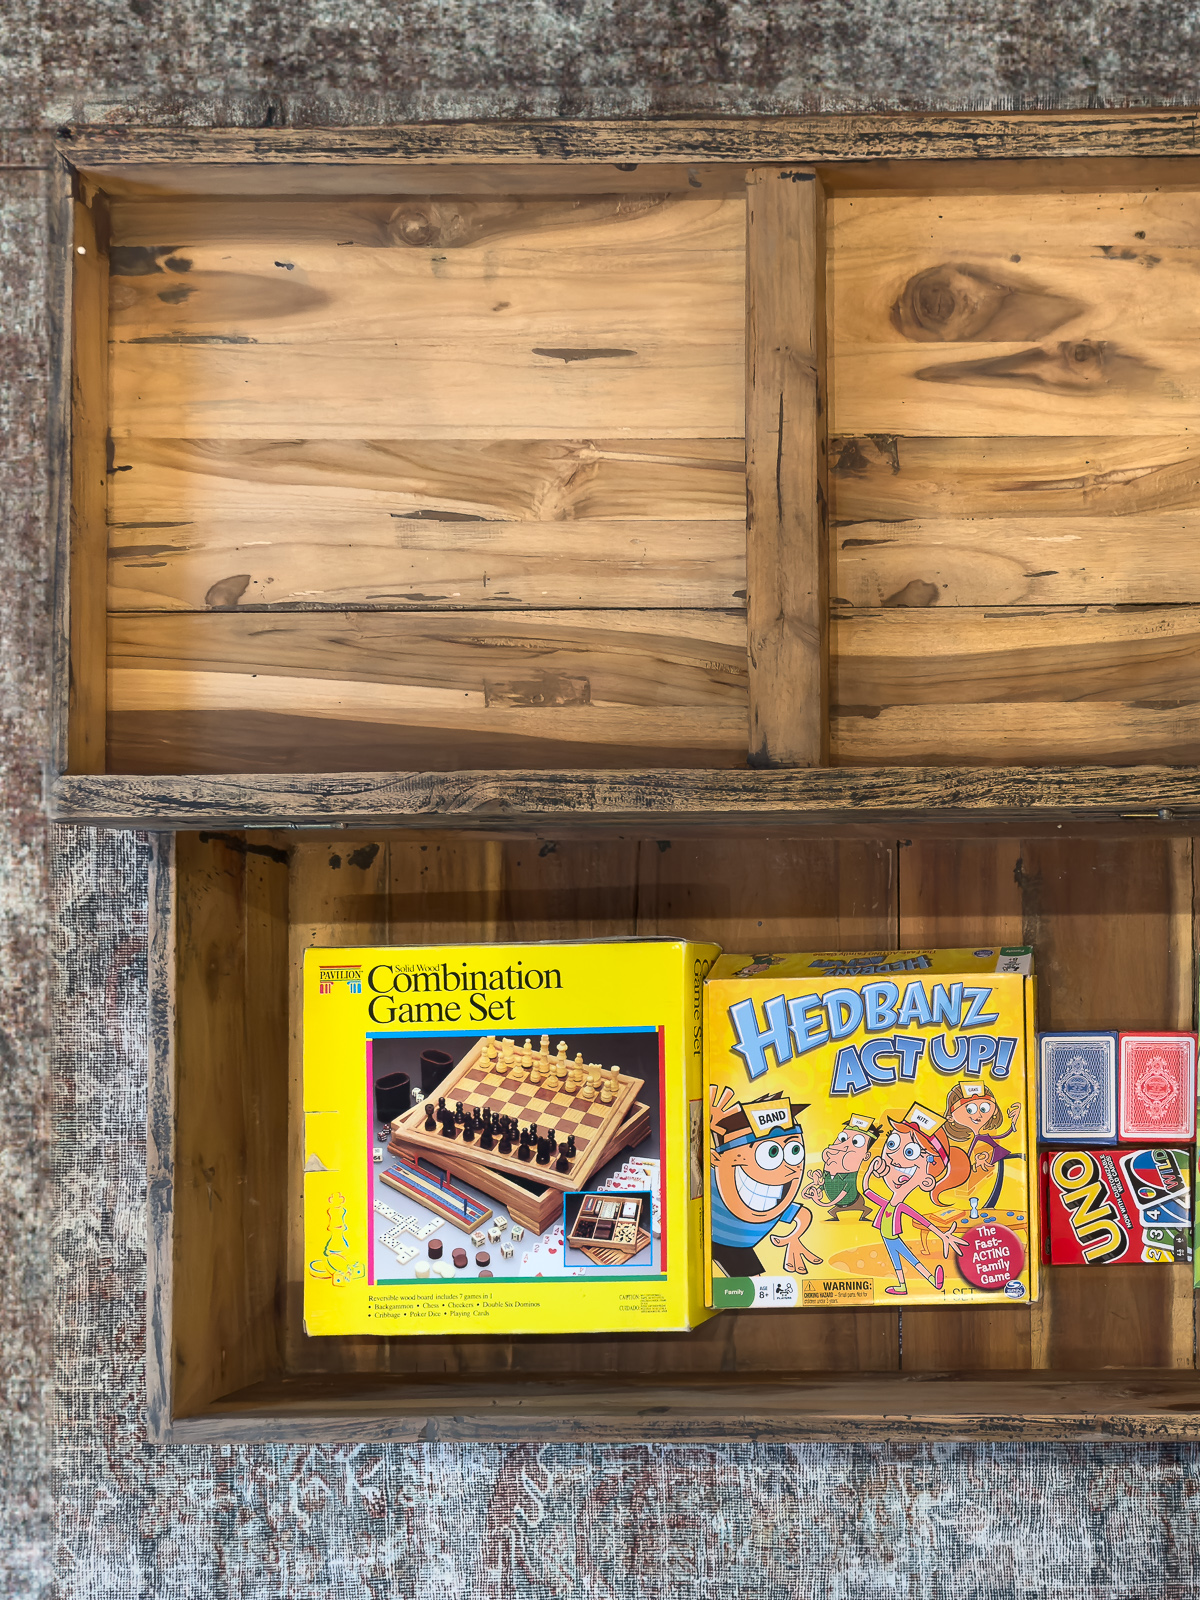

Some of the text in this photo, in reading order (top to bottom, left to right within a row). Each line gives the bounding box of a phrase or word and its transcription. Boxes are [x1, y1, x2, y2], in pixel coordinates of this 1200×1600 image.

[394, 963, 440, 973] Solid Wood
[822, 954, 933, 976] HEDBANZ
[320, 970, 361, 980] PAVILION
[368, 960, 563, 993] Combination
[368, 993, 517, 1024] Game Set
[693, 958, 702, 1057] Game Set
[729, 981, 999, 1080] HEDBANZ
[829, 1033, 1018, 1096] ACT UP!
[758, 1110, 786, 1126] BAND
[916, 1114, 929, 1125] KITE
[1152, 1149, 1179, 1190] WILD
[1100, 1154, 1133, 1229] NOW WITH CUSTOMIZABLE
[1114, 1177, 1124, 1192] WILD
[1050, 1150, 1130, 1263] UNO
[1146, 1209, 1161, 1220] 4
[976, 1226, 997, 1237] The
[1149, 1229, 1164, 1240] 3
[974, 1237, 1003, 1251] Fast-
[1148, 1248, 1162, 1261] 2
[976, 1258, 1010, 1274] Family
[980, 1272, 1011, 1284] Game
[823, 1280, 872, 1291] WARNING:
[759, 1291, 769, 1299] 8+
[449, 1310, 471, 1318] Playing
